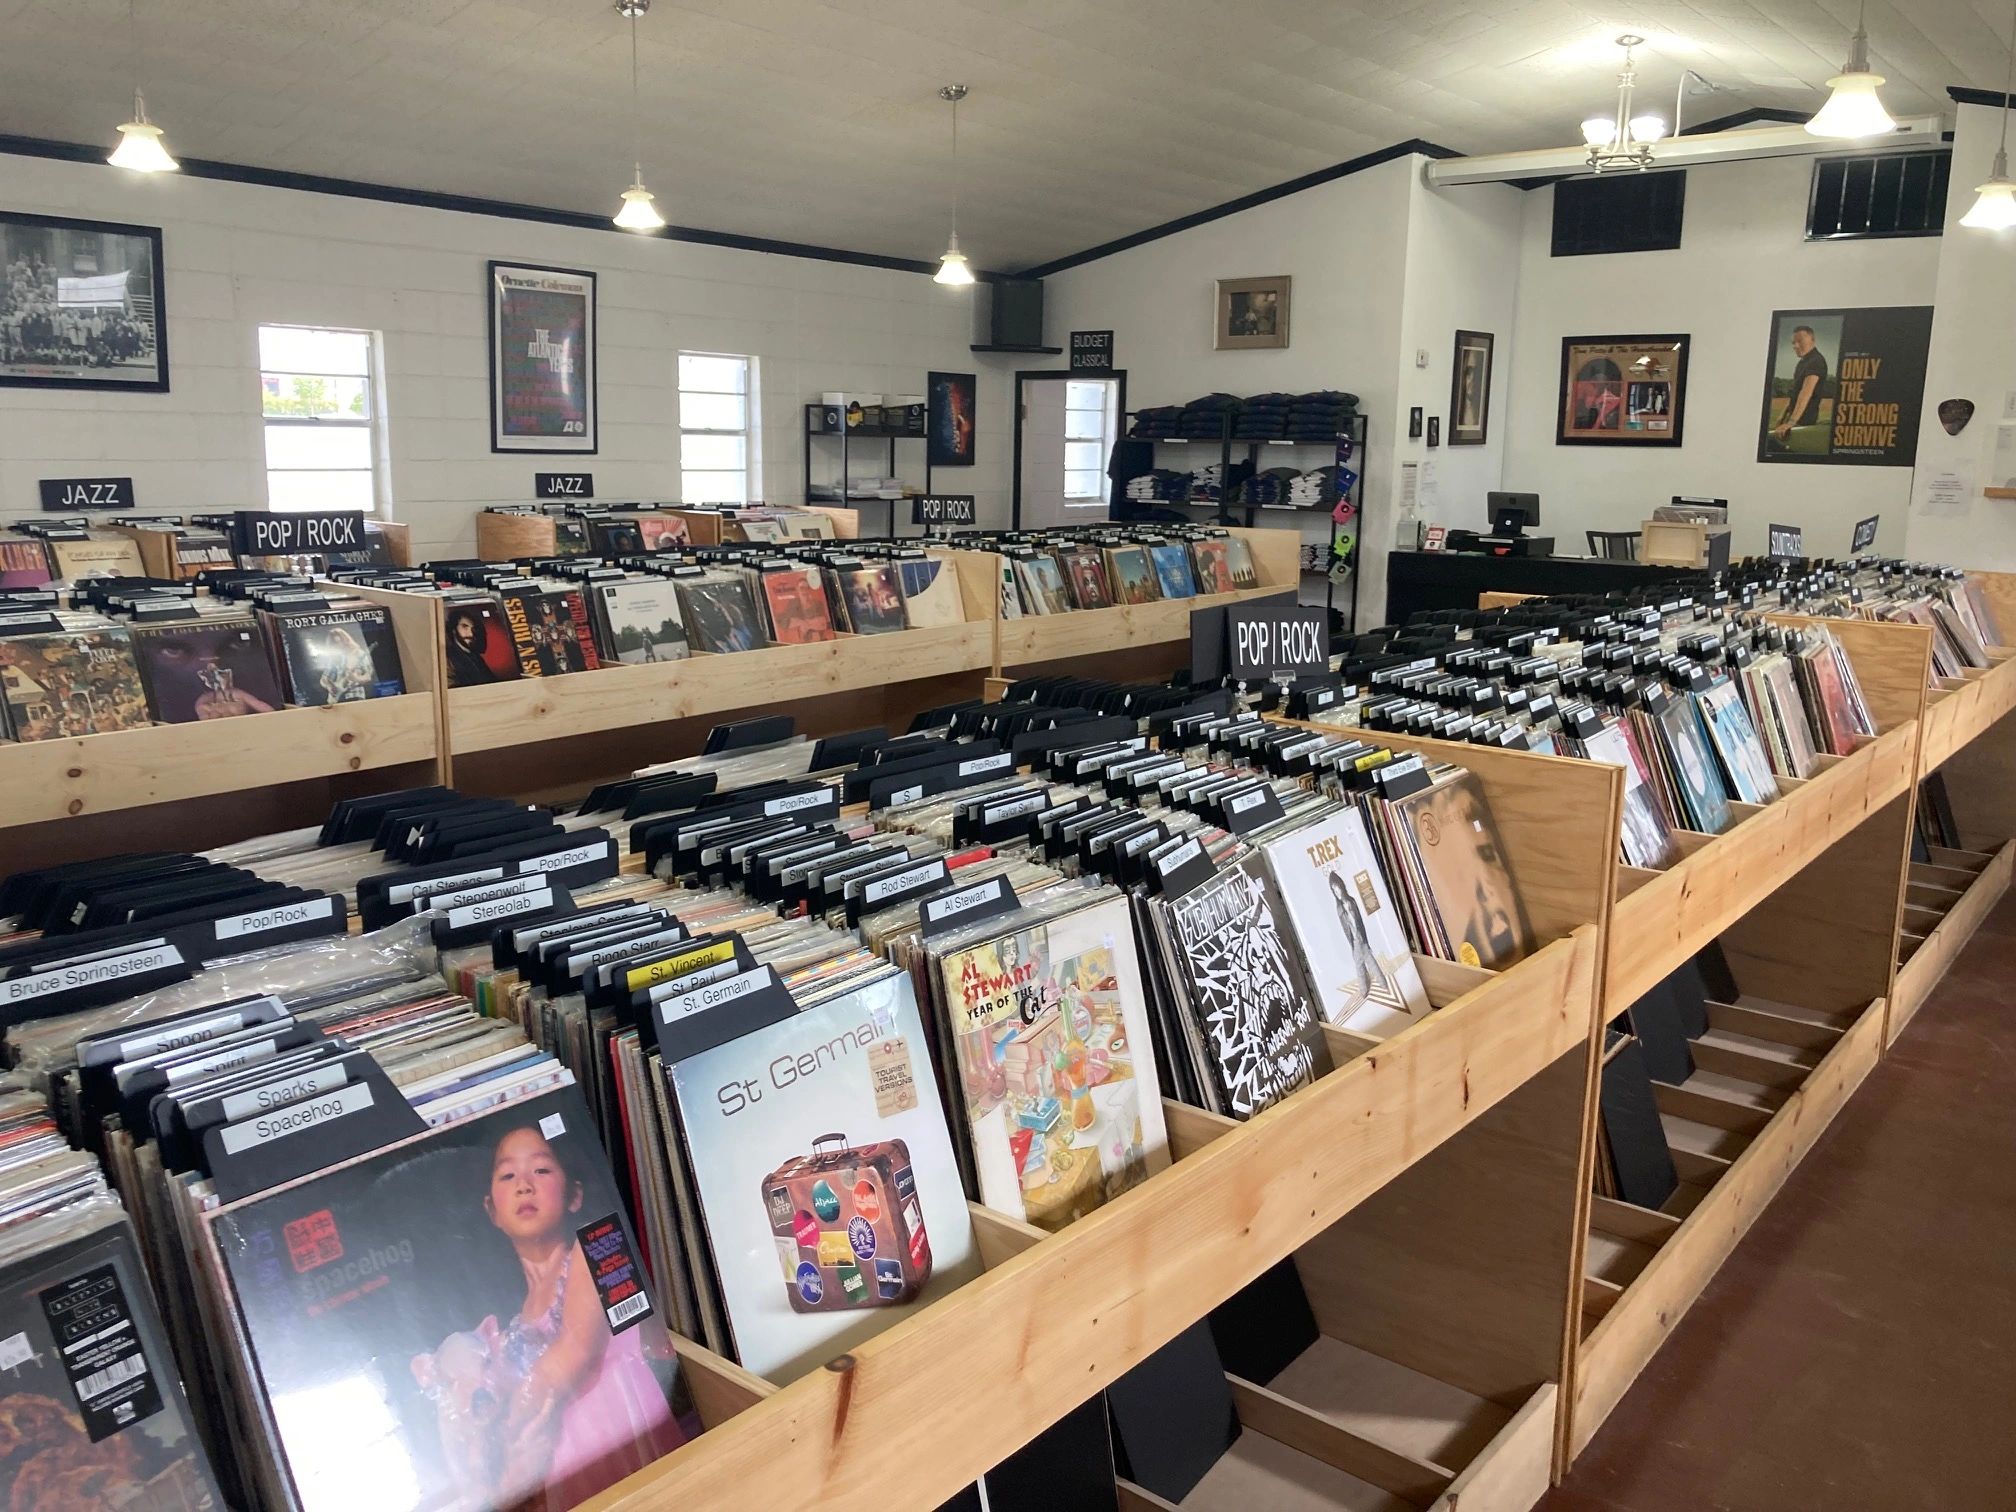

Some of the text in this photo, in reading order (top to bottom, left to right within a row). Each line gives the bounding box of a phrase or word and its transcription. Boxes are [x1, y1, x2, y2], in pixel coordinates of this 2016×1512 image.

[535, 329, 550, 342] THE
[1073, 334, 1110, 348] BUDGET
[1073, 353, 1110, 368] CLASSICAL
[1841, 357, 1883, 380] ONLY
[1840, 380, 1866, 402] THE
[1836, 402, 1899, 425] STRONG
[1833, 425, 1898, 448] SURVIVE
[62, 484, 120, 505] JAZZ
[548, 477, 584, 494] JAZZ
[922, 499, 941, 519] POP
[947, 500, 972, 520] ROCK
[256, 520, 292, 549] POP
[307, 517, 356, 547] ROCK
[285, 617, 317, 629] RORY
[1237, 621, 1269, 666] POP
[1280, 620, 1322, 665] ROCK
[779, 795, 819, 811] Pop/Rock
[903, 790, 911, 801] S
[539, 850, 590, 870] Pop/Rock
[411, 881, 434, 899] Cat
[881, 869, 931, 895] Rod Stewart
[472, 896, 531, 920] Stereolab
[944, 889, 988, 912] Al Stewart
[242, 906, 308, 931] Pop/Rock
[9, 952, 165, 998] Bruce Springsteen
[650, 951, 715, 982] St. Vincent
[961, 961, 981, 982] AL
[690, 970, 717, 988] Paul
[962, 963, 1032, 1006] STEWART
[683, 978, 751, 1013] St. Germain
[966, 986, 1058, 1025] YEAR OF THE Cat
[875, 1063, 907, 1079] TOURIST
[878, 1071, 907, 1085] TRAVEL
[257, 1077, 318, 1109] Sparks
[874, 1076, 913, 1094] VERSIONS
[717, 1077, 763, 1118] St
[256, 1098, 344, 1139] Spacehog
